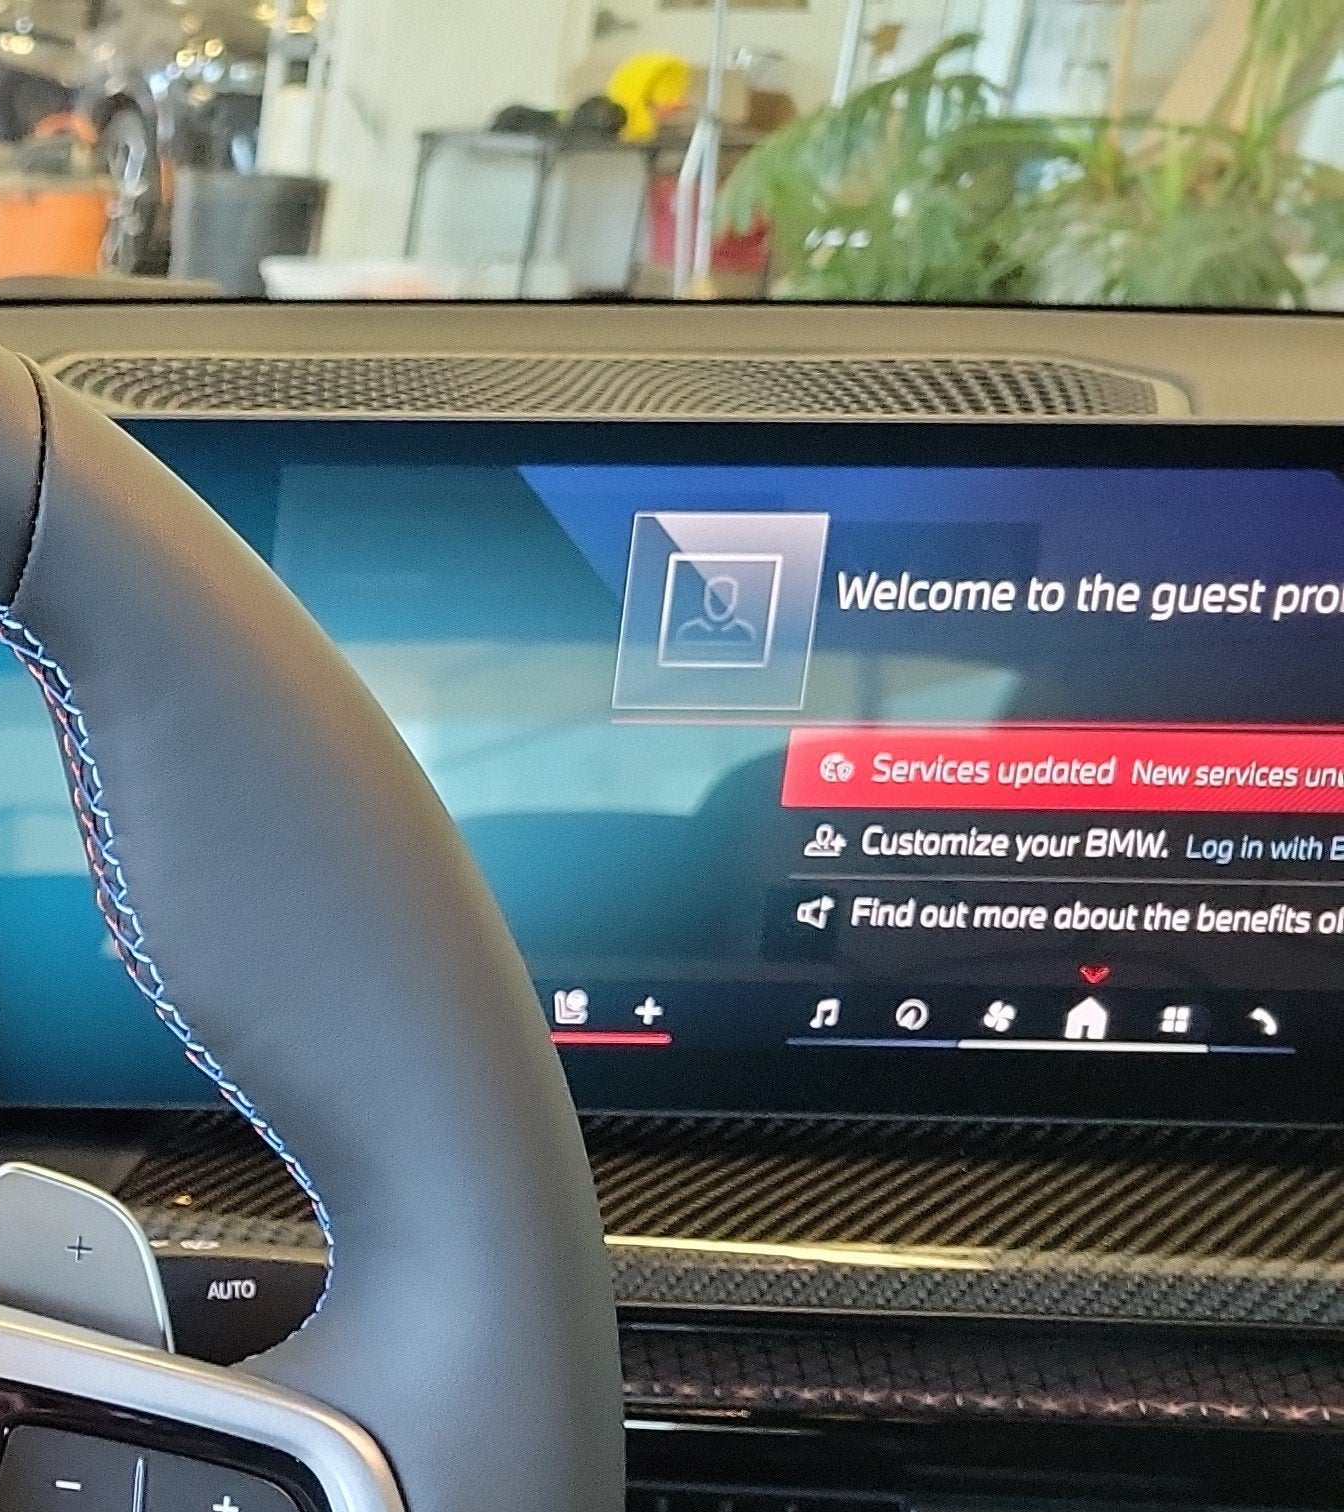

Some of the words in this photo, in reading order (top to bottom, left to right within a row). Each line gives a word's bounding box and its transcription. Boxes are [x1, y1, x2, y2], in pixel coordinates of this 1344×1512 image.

[837, 571, 1016, 613] Welcome
[1027, 576, 1065, 613] to
[1077, 573, 1141, 613] the
[1150, 578, 1266, 621] guest
[871, 752, 992, 785] Services
[998, 756, 1117, 789] updated
[1131, 760, 1187, 787] New
[1193, 761, 1298, 789] services
[861, 826, 1010, 858] Customize
[1015, 832, 1080, 862] your
[1084, 828, 1170, 860] BMW.
[1186, 834, 1232, 866] Log
[1240, 835, 1264, 860] in
[1270, 836, 1324, 861] with
[850, 897, 914, 929] Find
[919, 900, 969, 930] out
[973, 905, 1046, 931] more
[1053, 900, 1139, 932] about
[1144, 902, 1190, 932] the
[1195, 902, 1311, 935] benefits
[206, 1278, 258, 1301] AUTO
